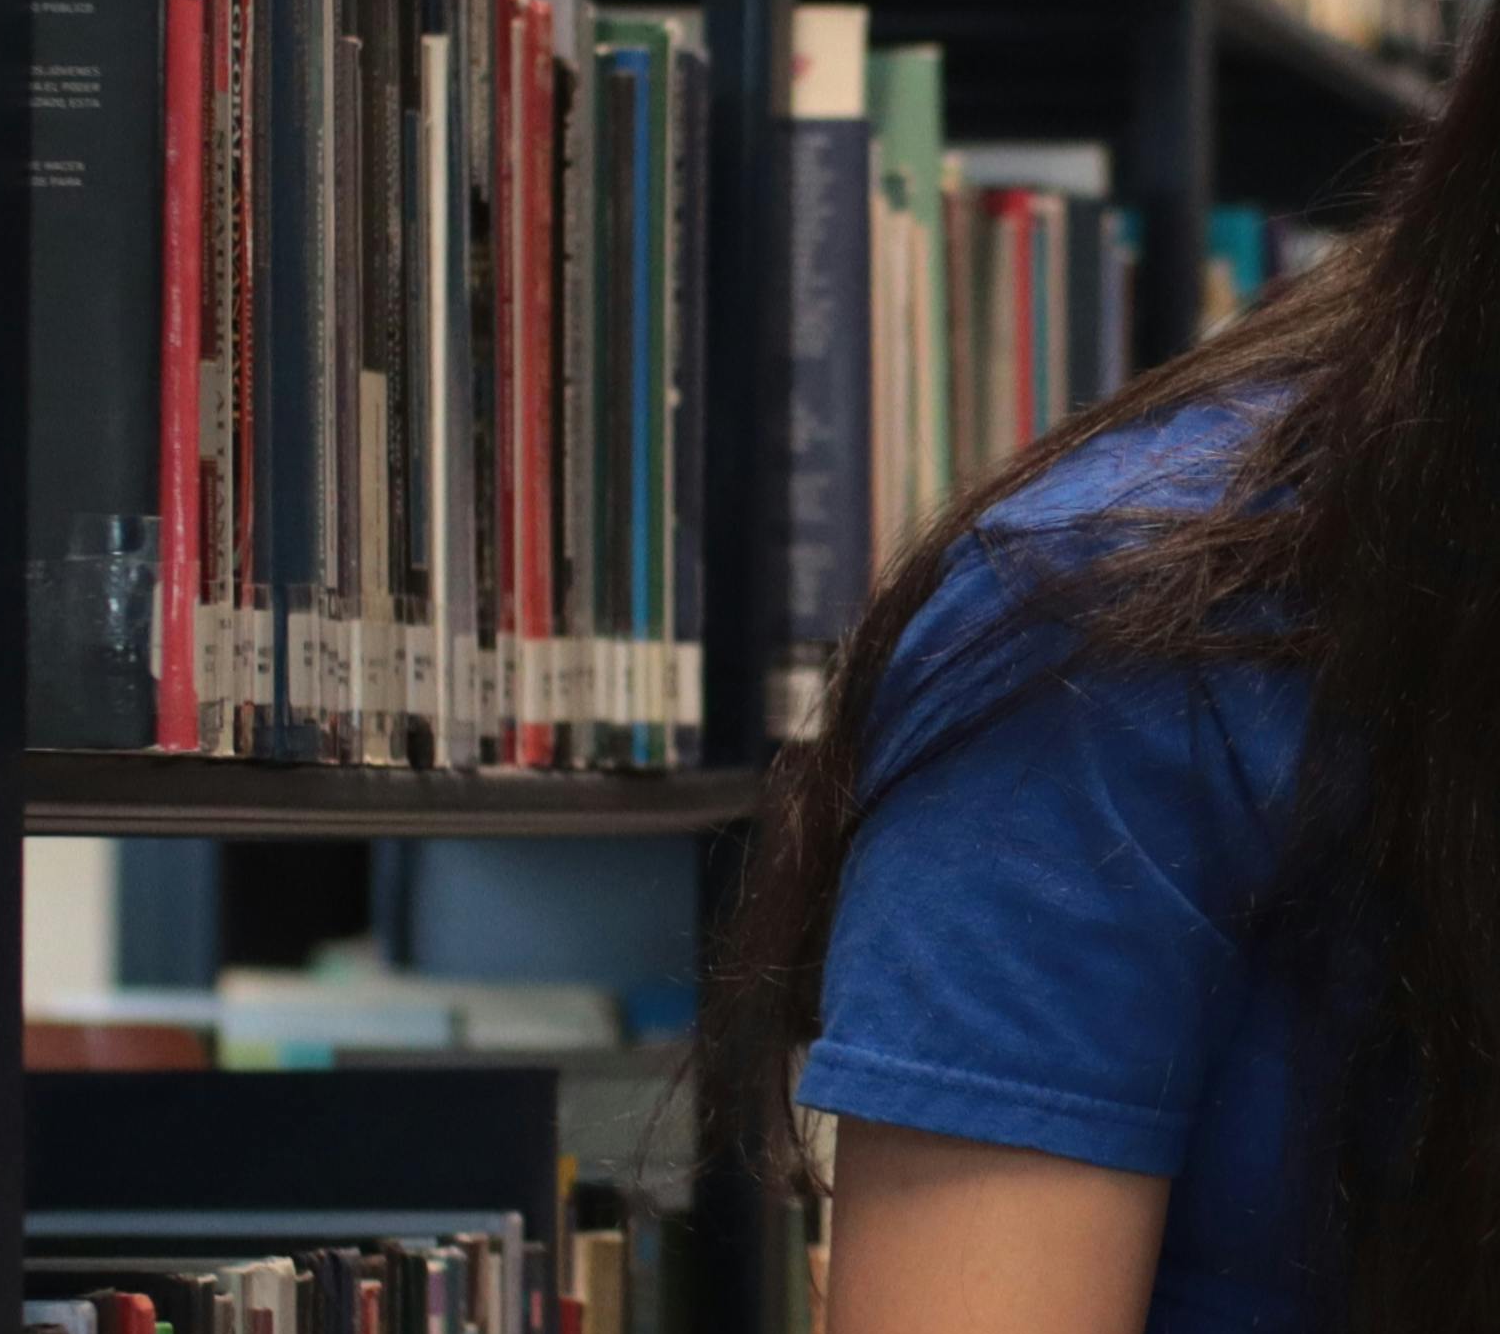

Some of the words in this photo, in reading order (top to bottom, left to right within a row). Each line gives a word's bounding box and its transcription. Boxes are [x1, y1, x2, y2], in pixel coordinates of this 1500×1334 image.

[231, 3, 243, 161] GLOBAL
[215, 129, 228, 377] STRATEGIC
[316, 183, 325, 279] Nature
